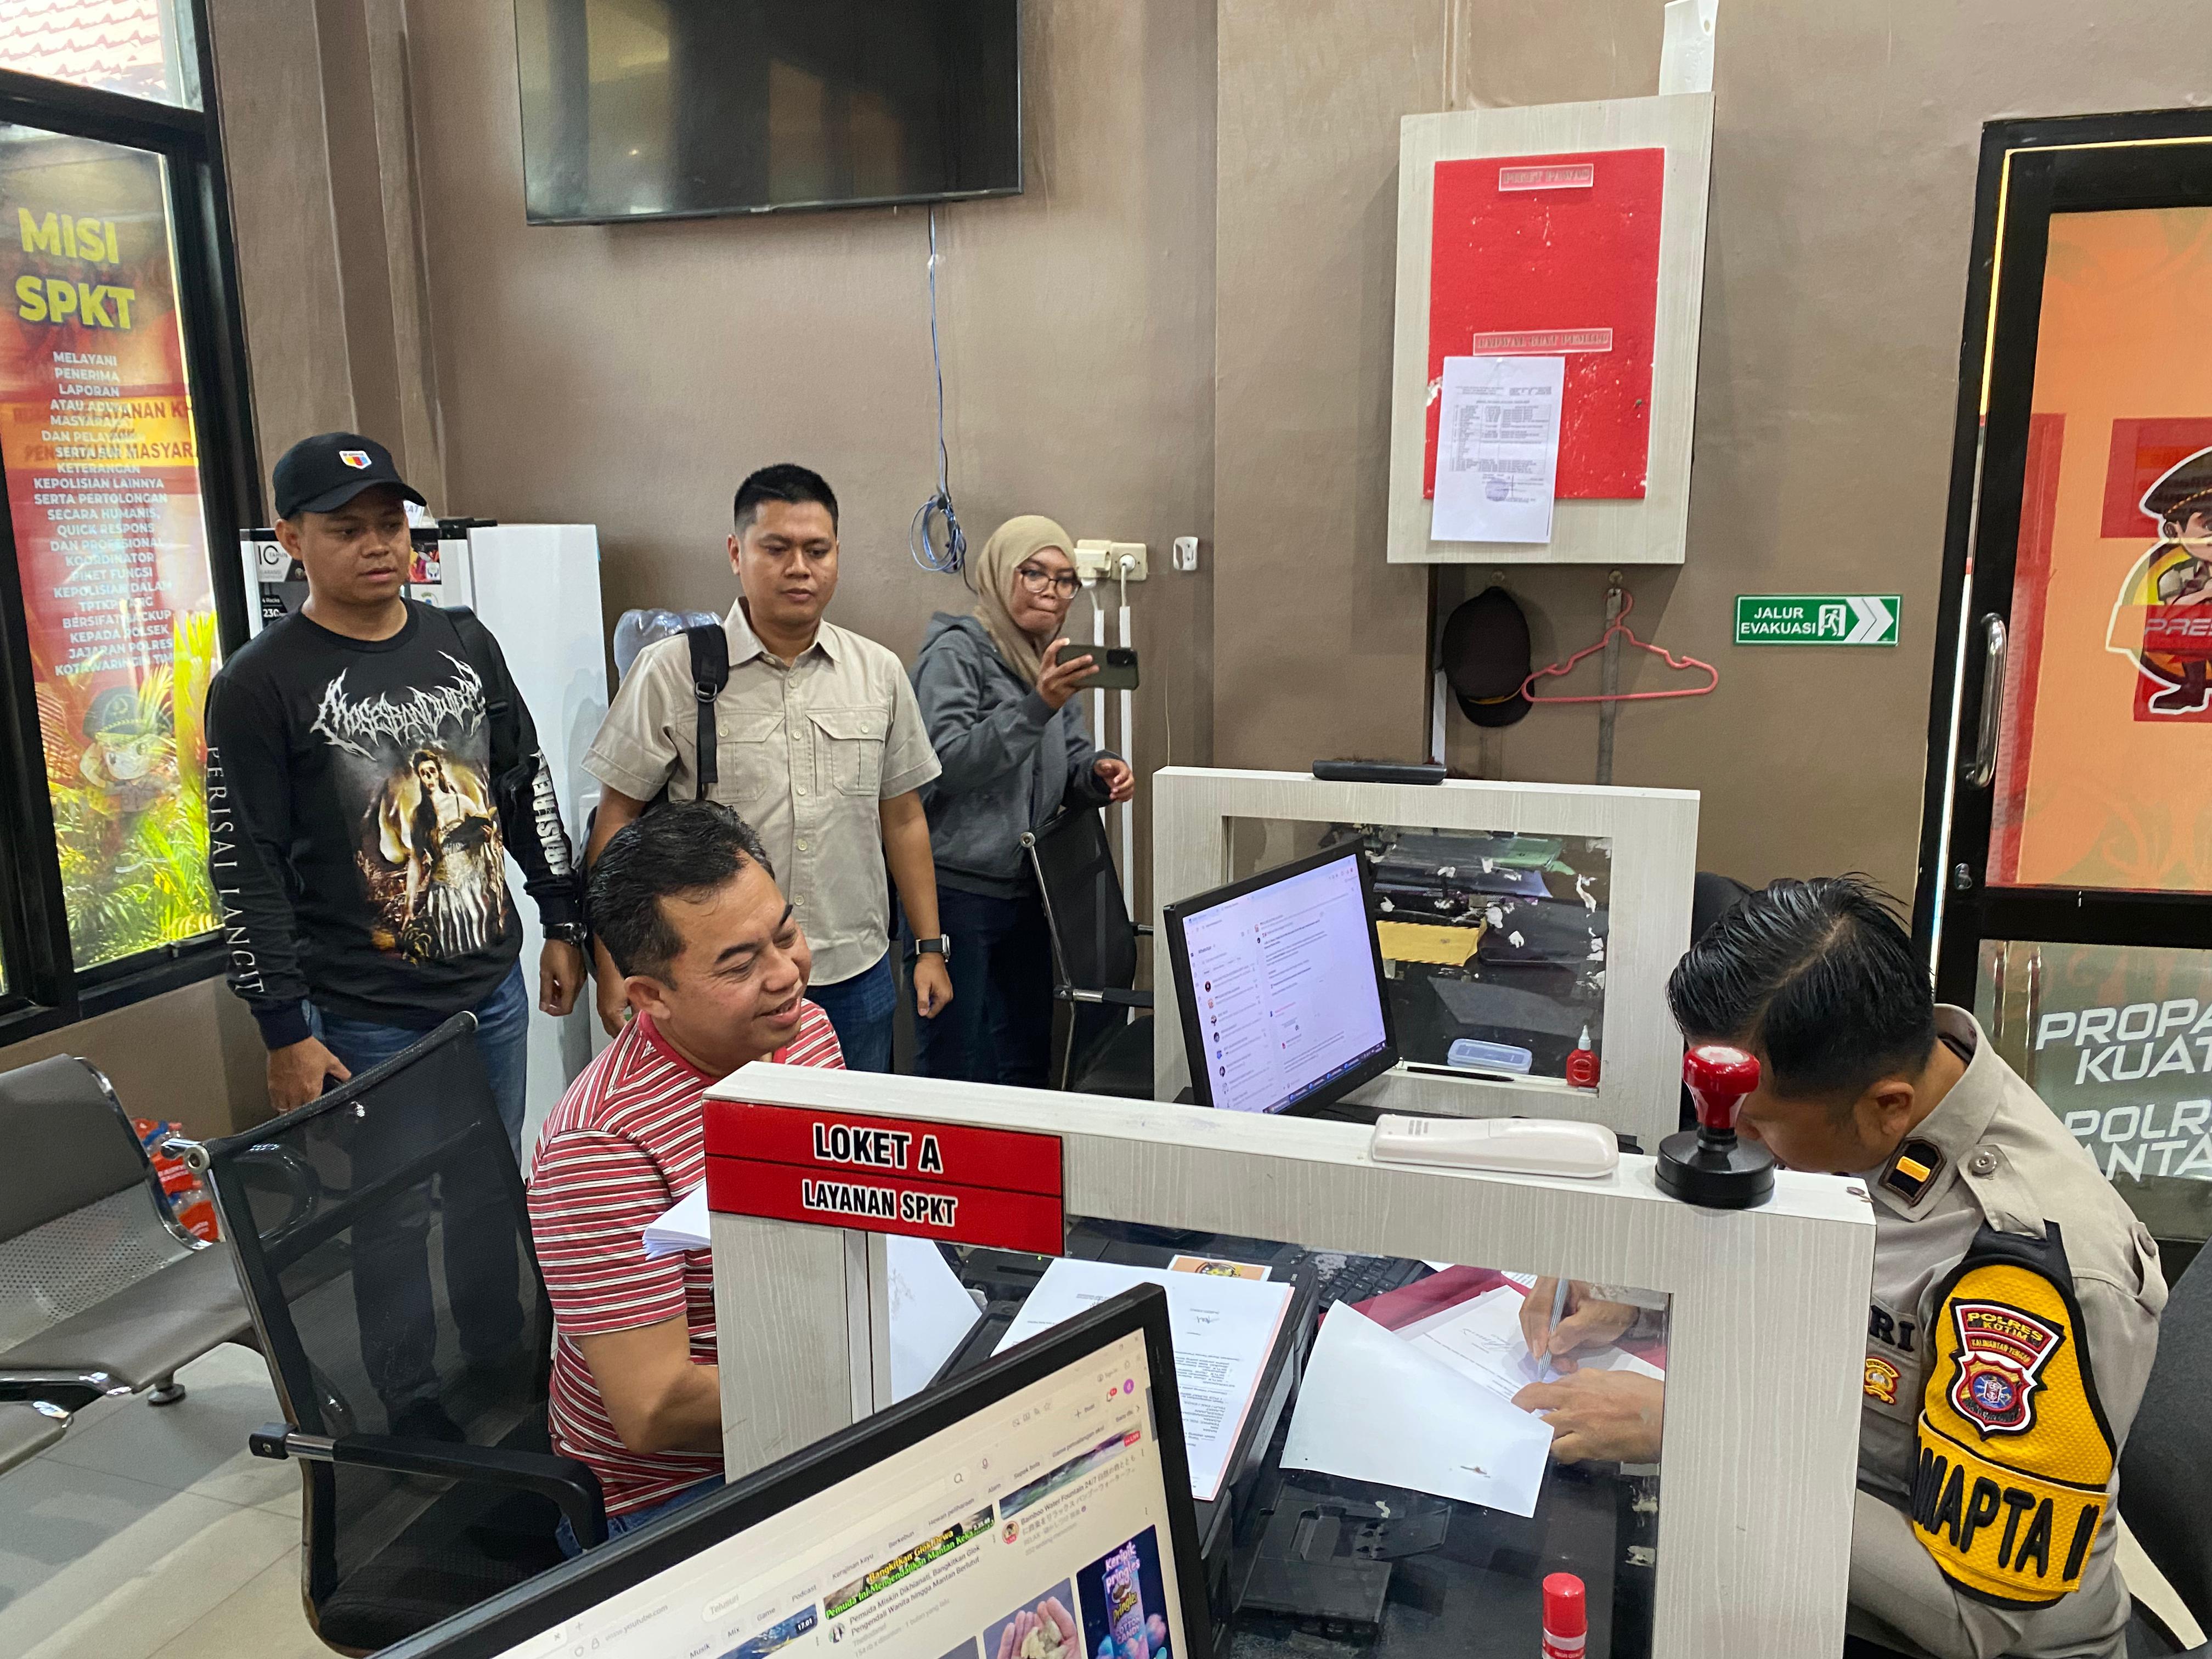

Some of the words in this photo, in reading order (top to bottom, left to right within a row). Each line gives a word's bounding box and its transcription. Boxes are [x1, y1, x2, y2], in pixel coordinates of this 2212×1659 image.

[18, 207, 119, 264] MISI
[15, 275, 135, 329] SPKT
[53, 351, 117, 366] MELAYANI
[55, 367, 120, 382] PENERIMA
[59, 383, 120, 397] LAPORAN
[50, 399, 83, 411] ATAU
[41, 430, 70, 442] DAN
[55, 445, 96, 459] SERTA
[57, 462, 140, 474] KETERANGAN
[33, 477, 109, 489] KEPOLISIAN
[113, 478, 164, 489] LAINNYA
[34, 493, 76, 505] SERTA
[78, 493, 167, 505] PERTOLONGAN
[47, 509, 98, 521] SECARA
[57, 524, 97, 538] QUICK
[100, 522, 155, 534] RESPONS
[50, 540, 78, 552] DAN
[65, 552, 155, 567] KOORDINATOR
[111, 566, 153, 579] FUNGSI
[53, 583, 128, 598] KEPOLISIAN
[63, 613, 121, 629] BERSIFAT
[1754, 607, 1804, 619] JALUR
[1740, 622, 1816, 635] EVAKUASI
[2145, 618, 2212, 636] PRE
[70, 629, 121, 644] KEPADA
[69, 644, 126, 659] JAJARAN
[128, 638, 173, 651] POLRES
[207, 746, 238, 868] PERISAI
[812, 1122, 912, 1170] LOKET
[918, 1133, 944, 1174] A
[802, 1180, 897, 1221] LAYANAN
[900, 1190, 958, 1227] SPKT
[1967, 1312, 2043, 1342] POLRES
[1983, 1321, 2028, 1341] KOTIM
[1021, 1506, 1044, 1525] Bamboo
[1044, 1498, 1061, 1513] Water
[1061, 1485, 1085, 1503] Fountain
[1105, 1541, 1137, 1571] Keripik
[869, 1551, 913, 1582] Bangkitkan
[825, 1598, 857, 1619] Pemuda
[927, 1541, 956, 1561] Mantan
[849, 1604, 877, 1624] Pemuda
[877, 1592, 899, 1609] Miskin
[932, 1554, 966, 1578] Bangkitkan
[966, 1544, 980, 1557] Glok
[1105, 1558, 1141, 1594] pringles
[792, 1584, 817, 1602] Podcast
[850, 1611, 887, 1637] Pengendali
[888, 1599, 910, 1614] Wanita
[910, 1585, 932, 1601] hingga
[932, 1571, 956, 1589] Mantan
[1113, 1592, 1138, 1628] Pringles
[757, 1606, 776, 1622] Game
[605, 1604, 668, 1641] www.youtube.com
[1115, 1617, 1141, 1637] COTTON
[727, 1626, 740, 1638] Mix
[1116, 1624, 1140, 1645] CANDY
[689, 1643, 711, 1659] Musik
